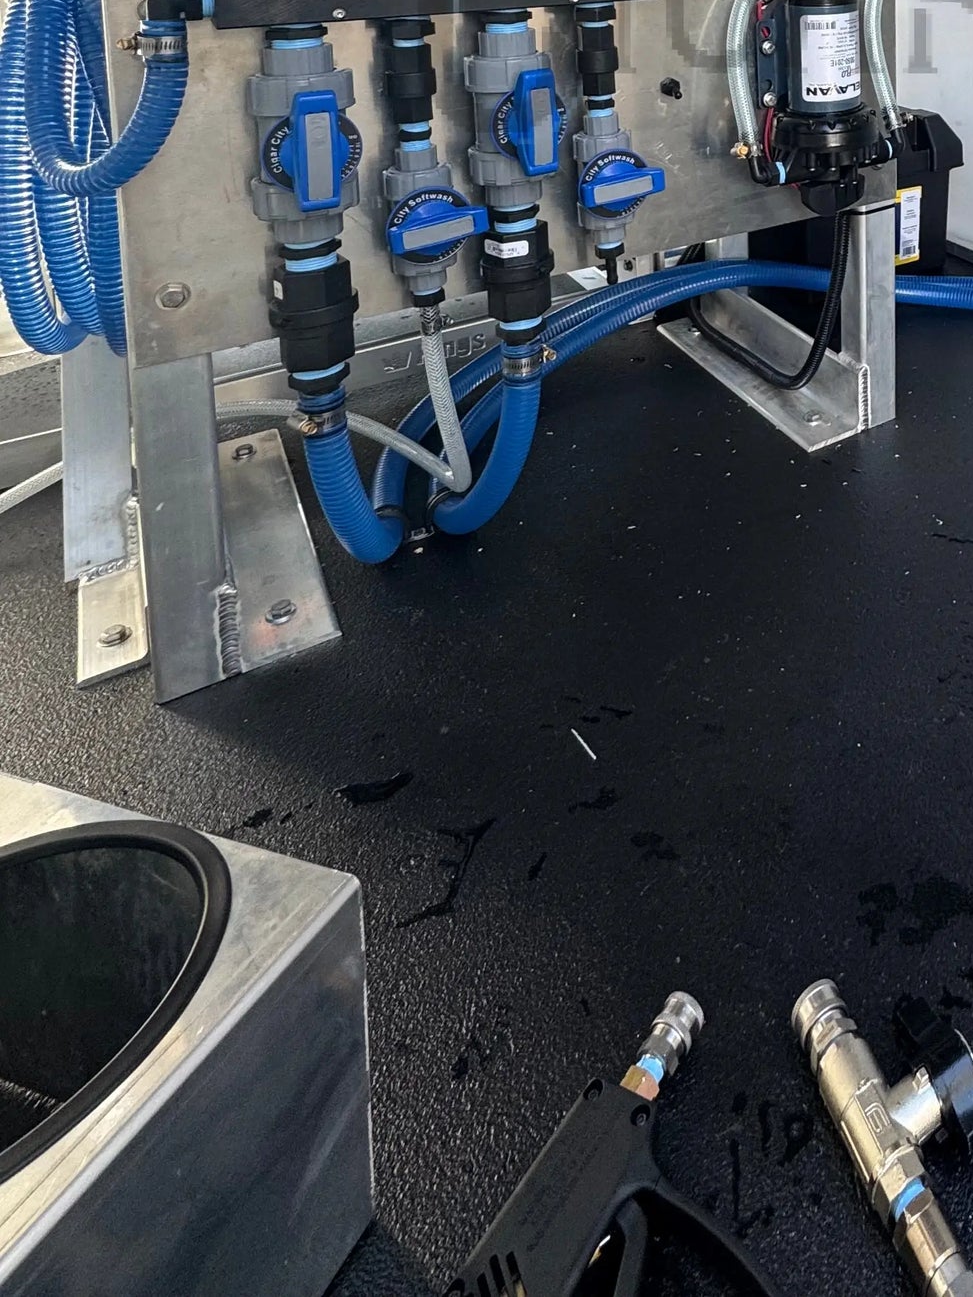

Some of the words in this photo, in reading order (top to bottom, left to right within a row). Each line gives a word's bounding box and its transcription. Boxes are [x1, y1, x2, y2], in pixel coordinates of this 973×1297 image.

[271, 125, 292, 146] City
[270, 146, 283, 174] Cigar
[585, 165, 600, 182] City
[597, 154, 636, 167] Softwash
[393, 205, 411, 225] City
[407, 193, 454, 207] Softwash
